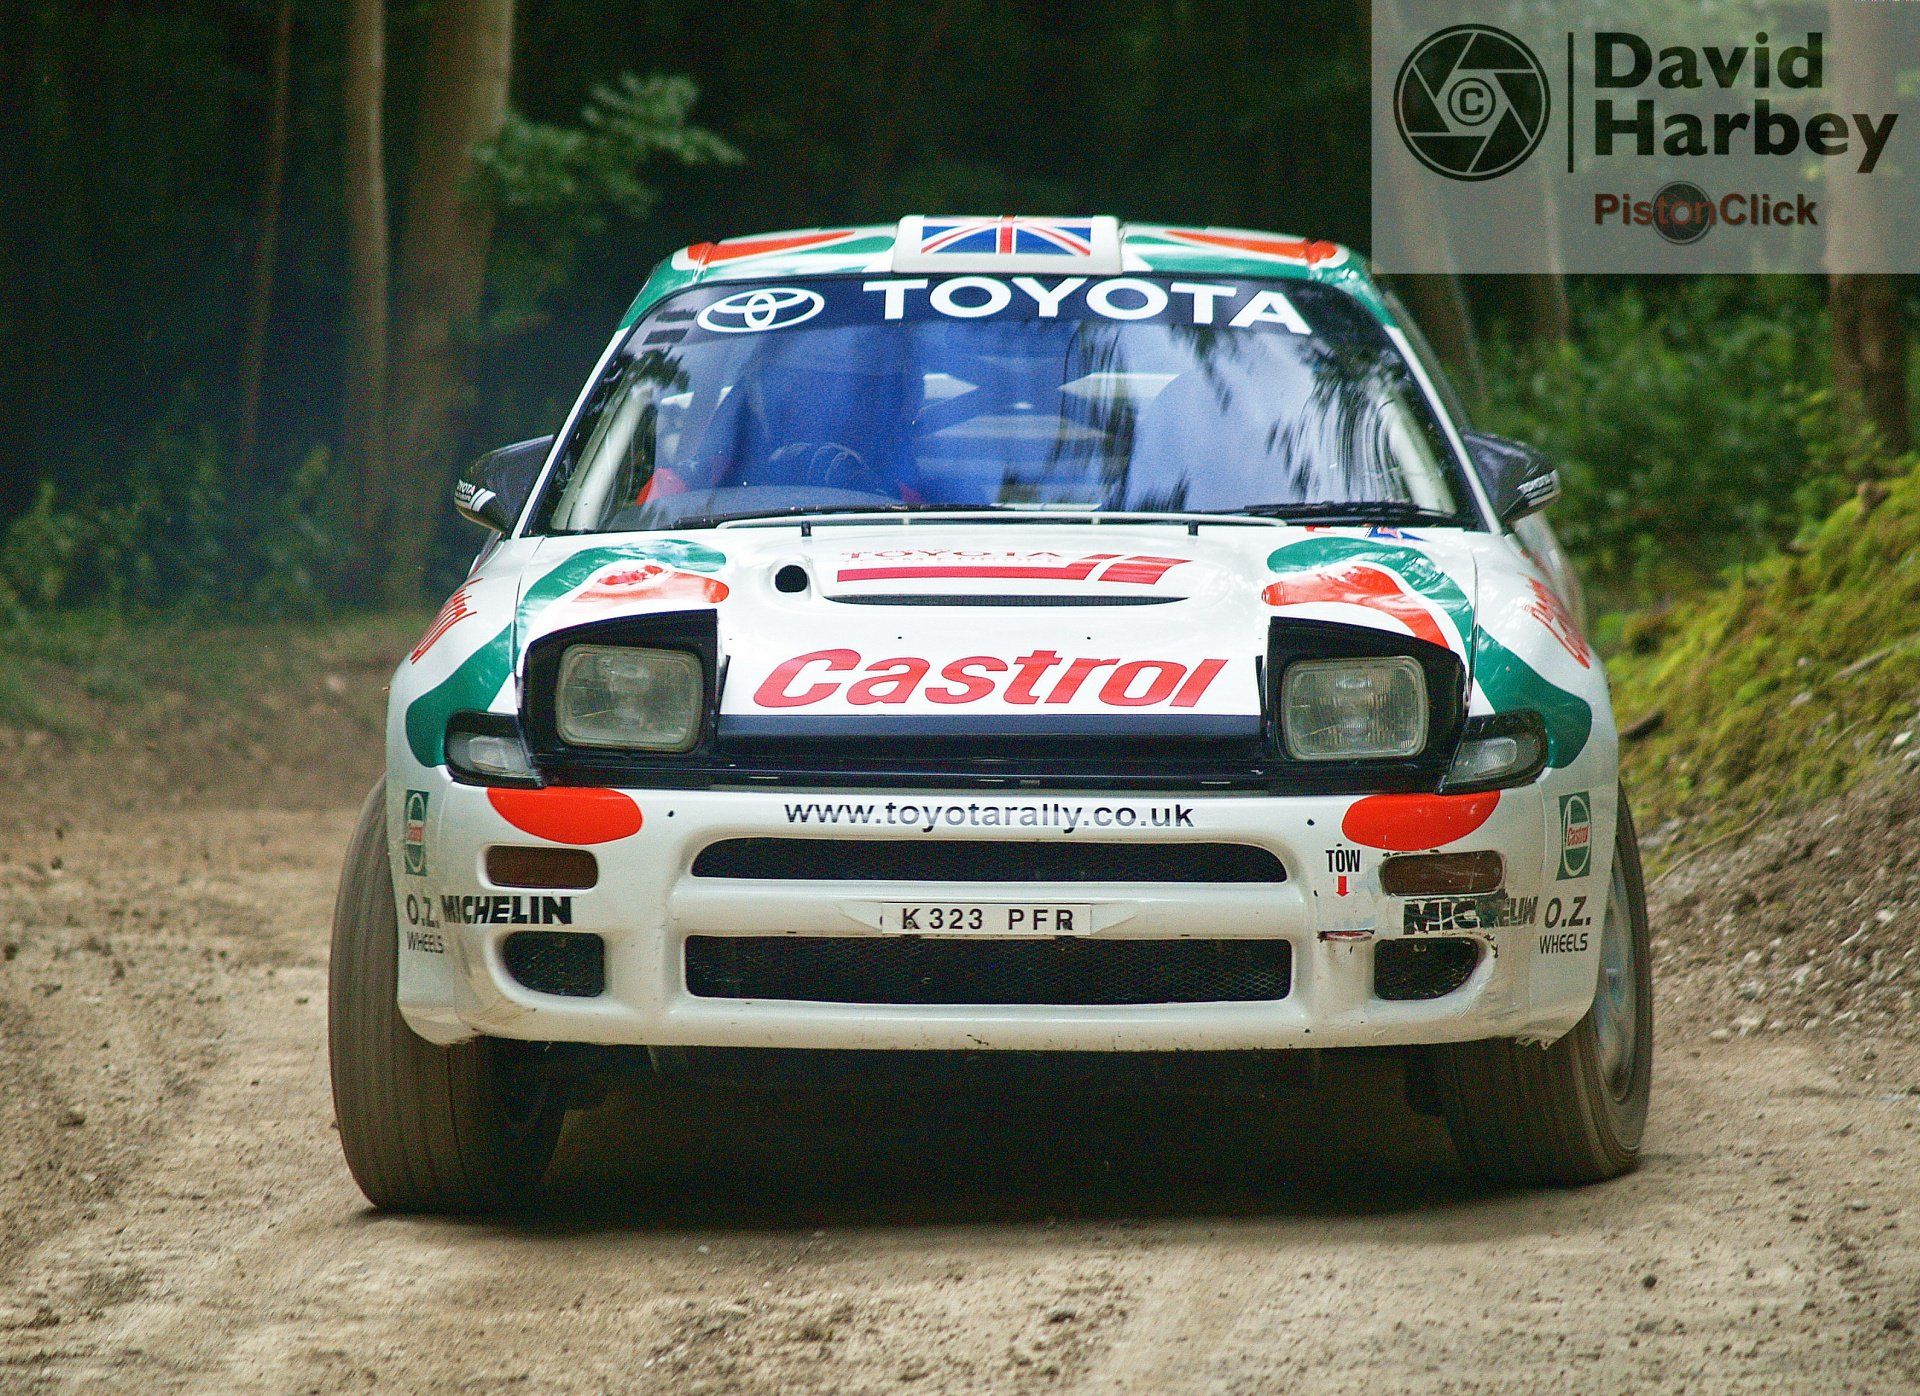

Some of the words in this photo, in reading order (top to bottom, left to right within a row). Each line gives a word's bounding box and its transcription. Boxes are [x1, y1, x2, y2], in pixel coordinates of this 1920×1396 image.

[862, 276, 1312, 335] TOYOTA
[753, 648, 1228, 708] Castrol
[785, 803, 1194, 833] www.toyotarally.co.uk
[1325, 849, 1361, 873] TOW
[441, 895, 573, 925] MICHELIN
[1008, 908, 1073, 931] PFR
[1544, 895, 1592, 929] O.Z.
[1539, 933, 1588, 954] WHEELS
